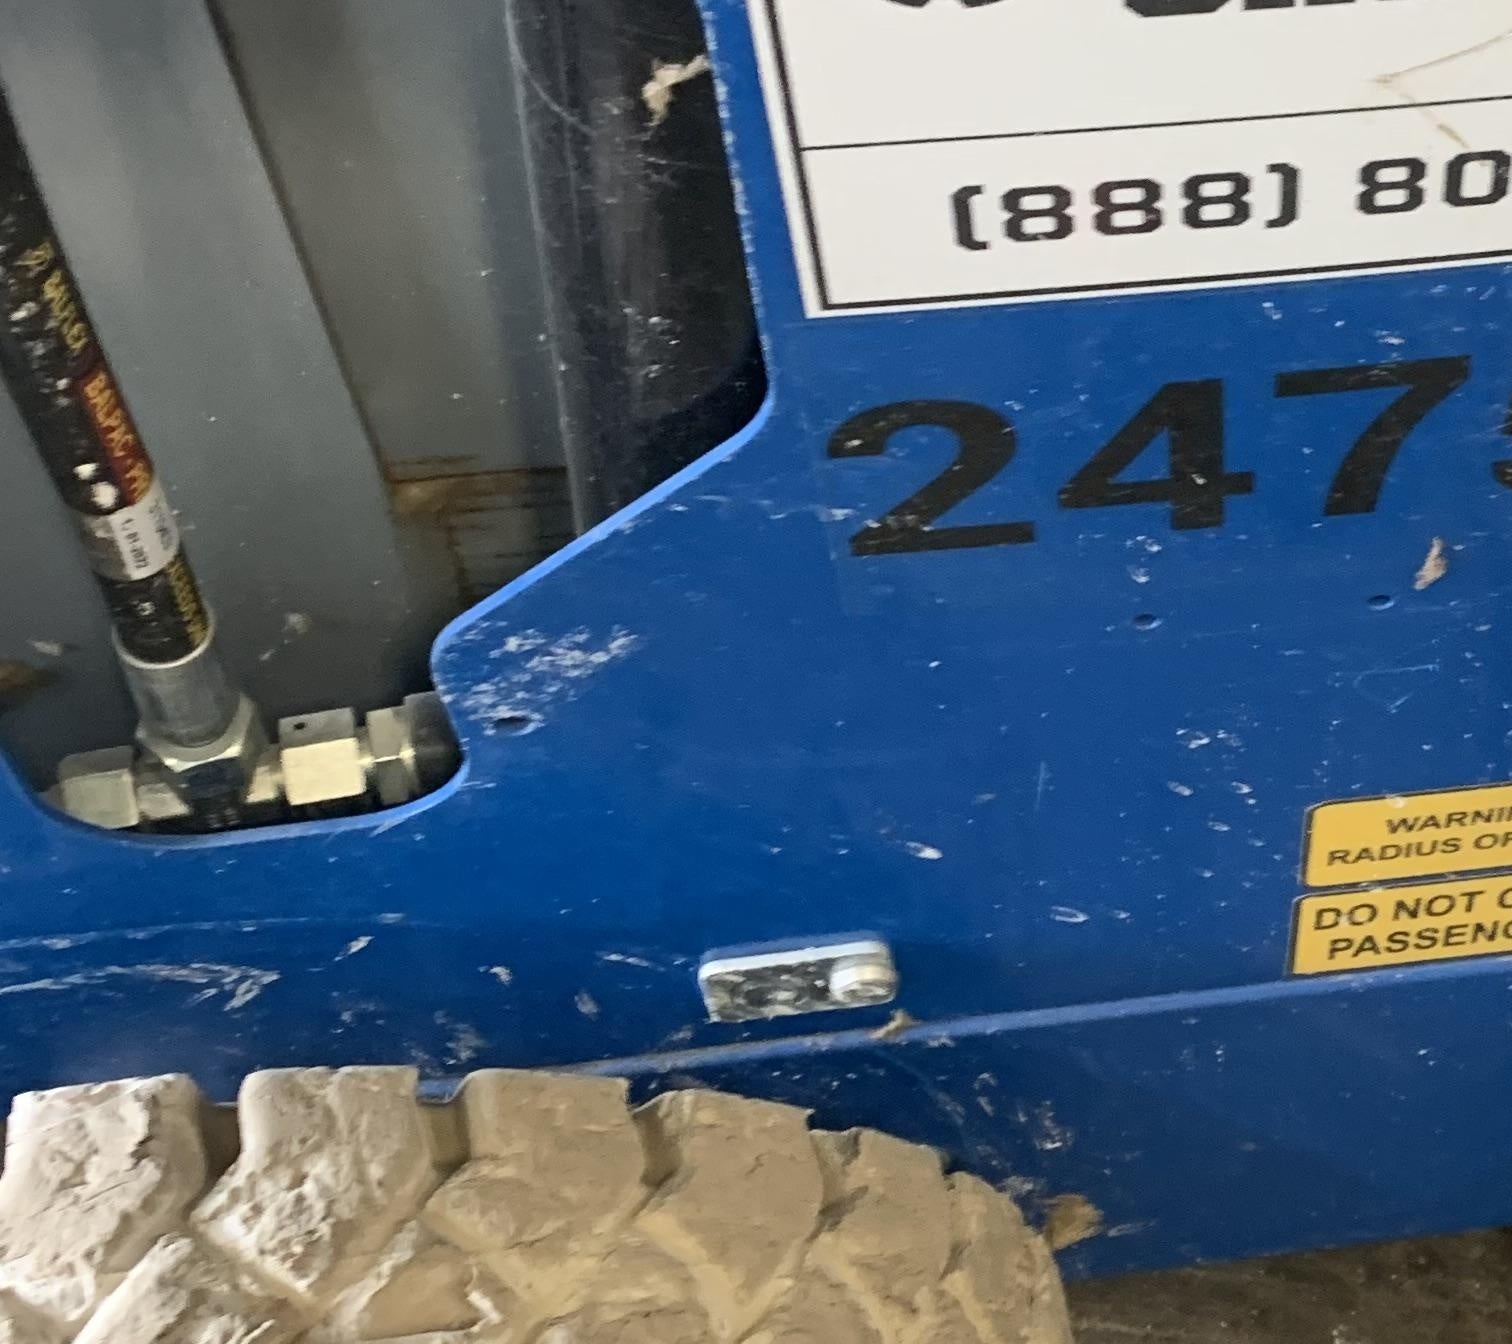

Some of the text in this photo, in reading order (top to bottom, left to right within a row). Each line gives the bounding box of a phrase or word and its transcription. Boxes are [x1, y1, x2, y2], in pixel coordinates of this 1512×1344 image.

[951, 161, 1300, 252] (888)
[1326, 837, 1462, 867] RADIUS
[1313, 902, 1380, 931] DO
[1391, 888, 1486, 923] NOT
